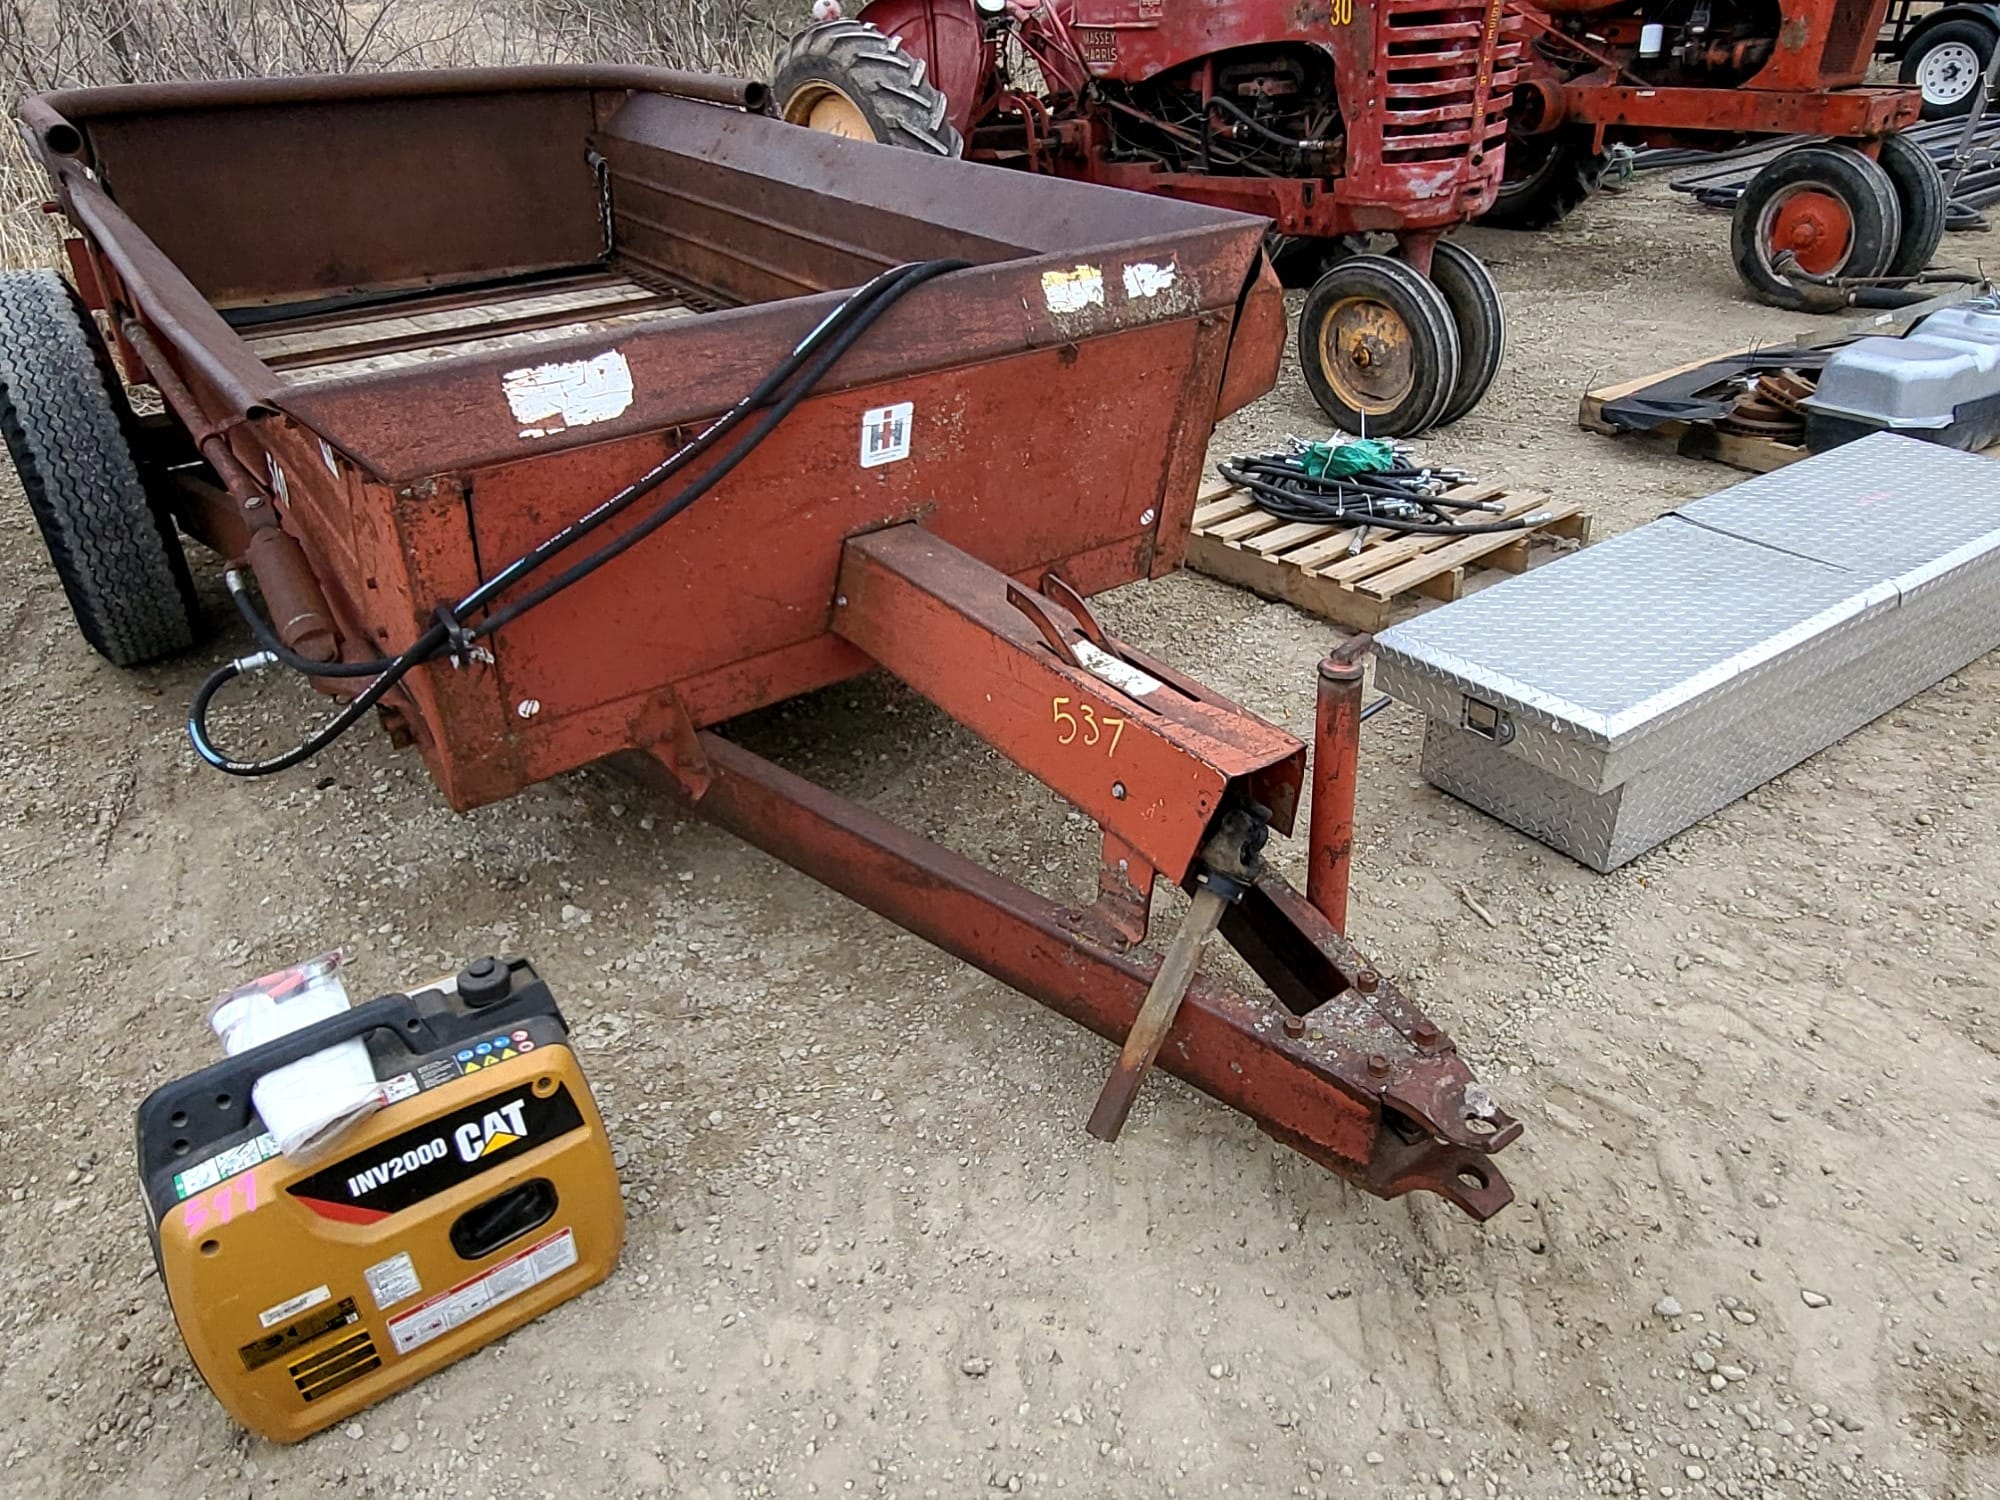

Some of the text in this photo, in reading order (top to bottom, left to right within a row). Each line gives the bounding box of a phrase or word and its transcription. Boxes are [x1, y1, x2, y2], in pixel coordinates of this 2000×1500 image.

[1330, 0, 1352, 26] 30
[1083, 31, 1116, 45] MASSEY
[1083, 48, 1118, 61] HARRIS
[1053, 697, 1125, 758] 537
[347, 1138, 448, 1197] INV2000
[455, 1099, 528, 1162] CAT
